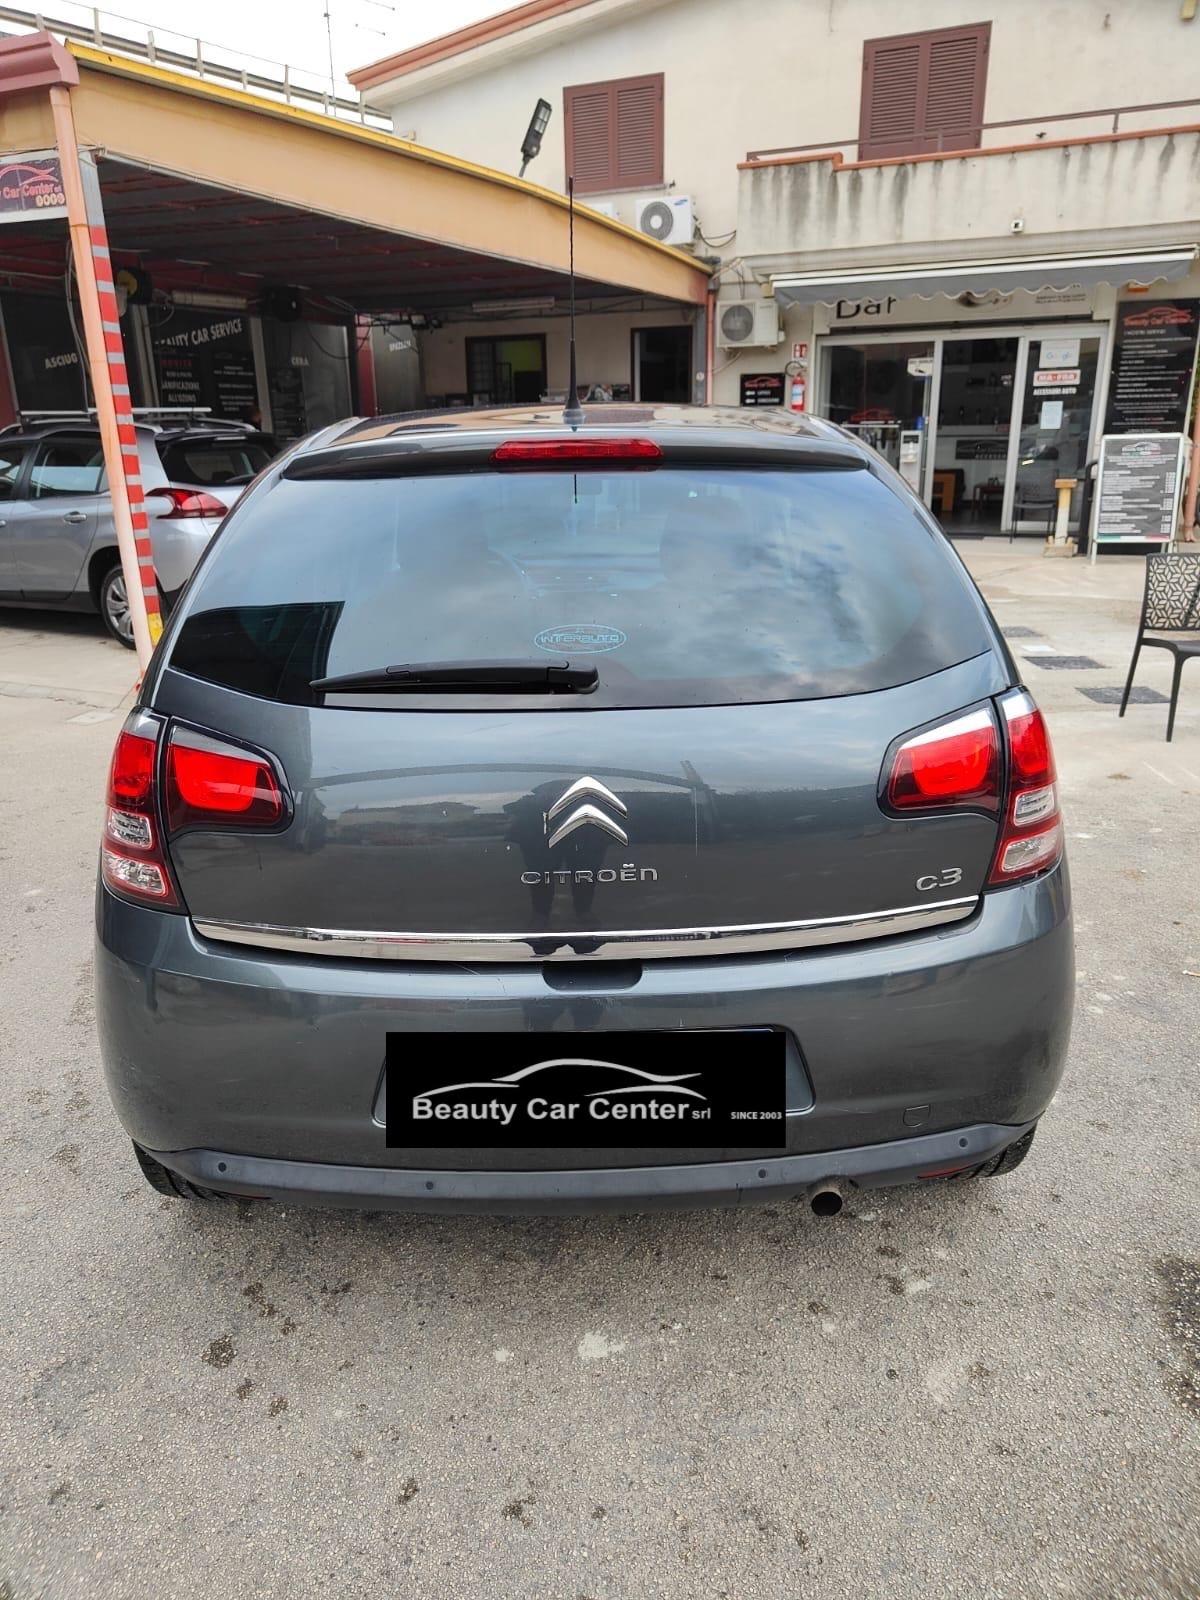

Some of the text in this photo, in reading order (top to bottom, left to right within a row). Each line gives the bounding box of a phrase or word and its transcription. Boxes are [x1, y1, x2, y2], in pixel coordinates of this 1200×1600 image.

[191, 327, 210, 345] CAR
[210, 318, 243, 341] SERVICE
[520, 863, 659, 884] CITROËN
[916, 867, 963, 891] C3
